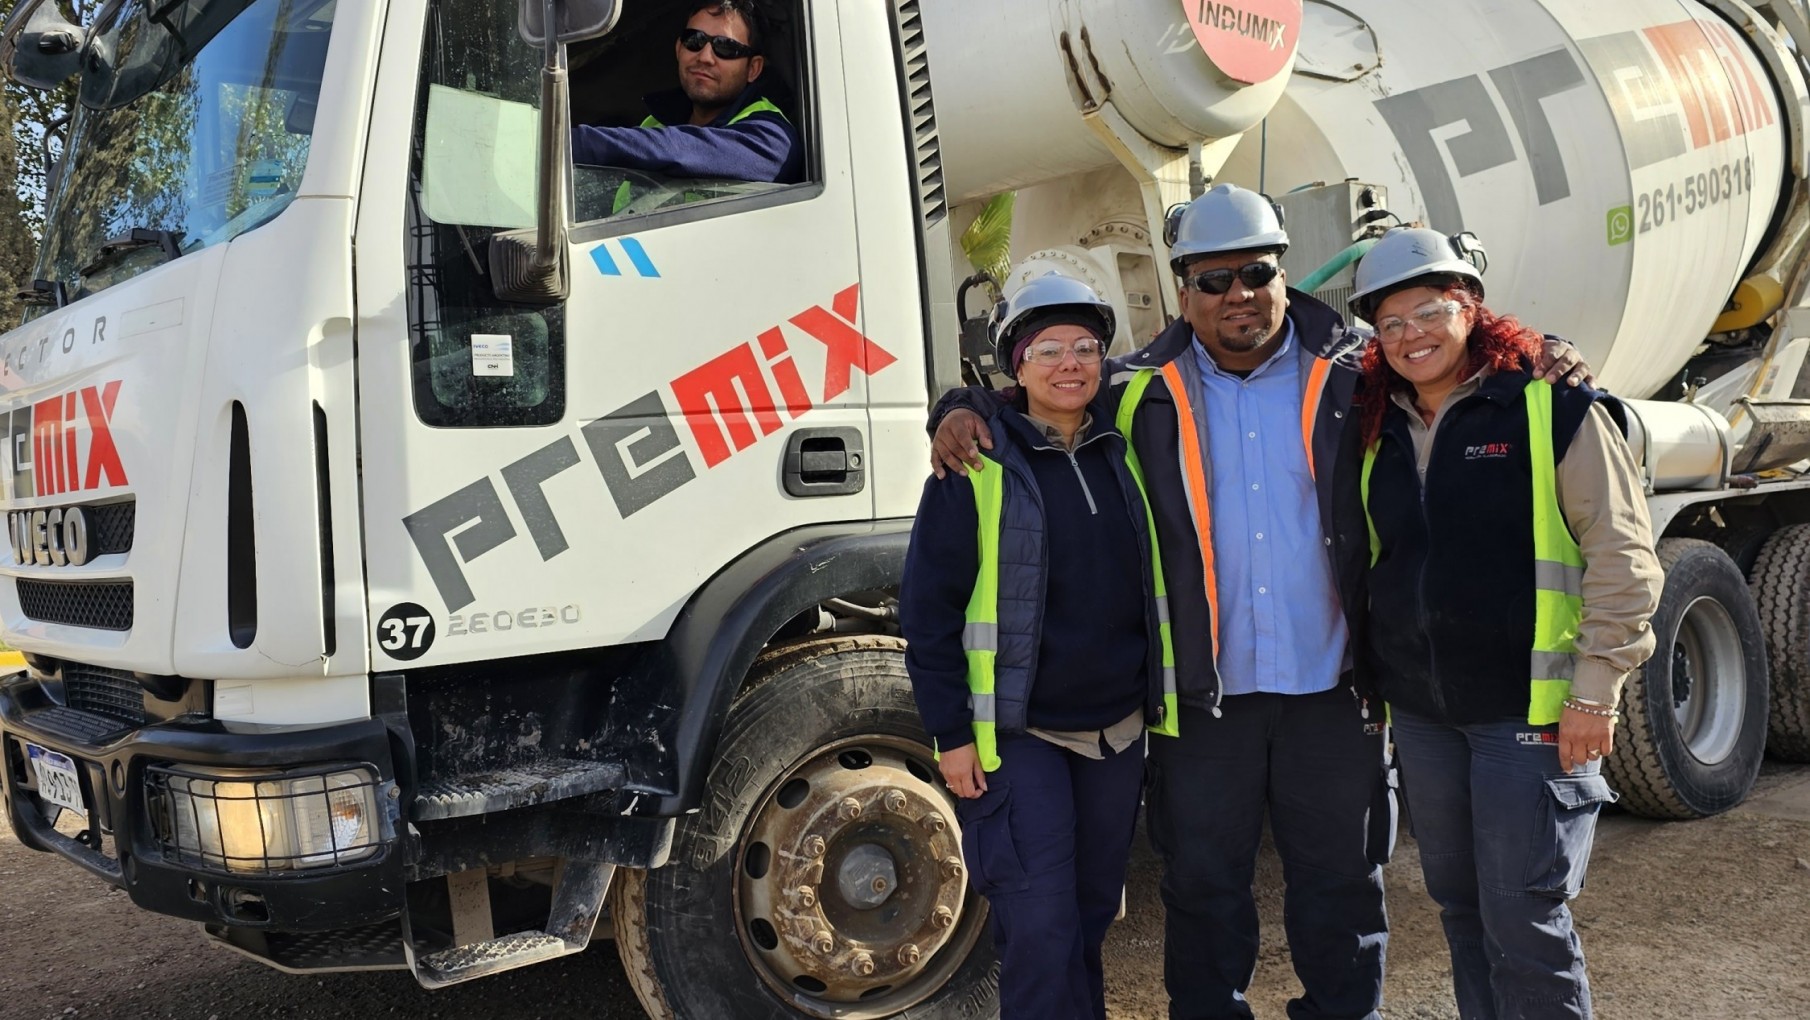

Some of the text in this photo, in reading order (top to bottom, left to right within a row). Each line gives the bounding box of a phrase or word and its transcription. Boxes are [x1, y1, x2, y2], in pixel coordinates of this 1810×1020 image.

[1198, 0, 1286, 51] INDUMIX
[8, 506, 88, 567] IVECO
[381, 617, 431, 650] 37
